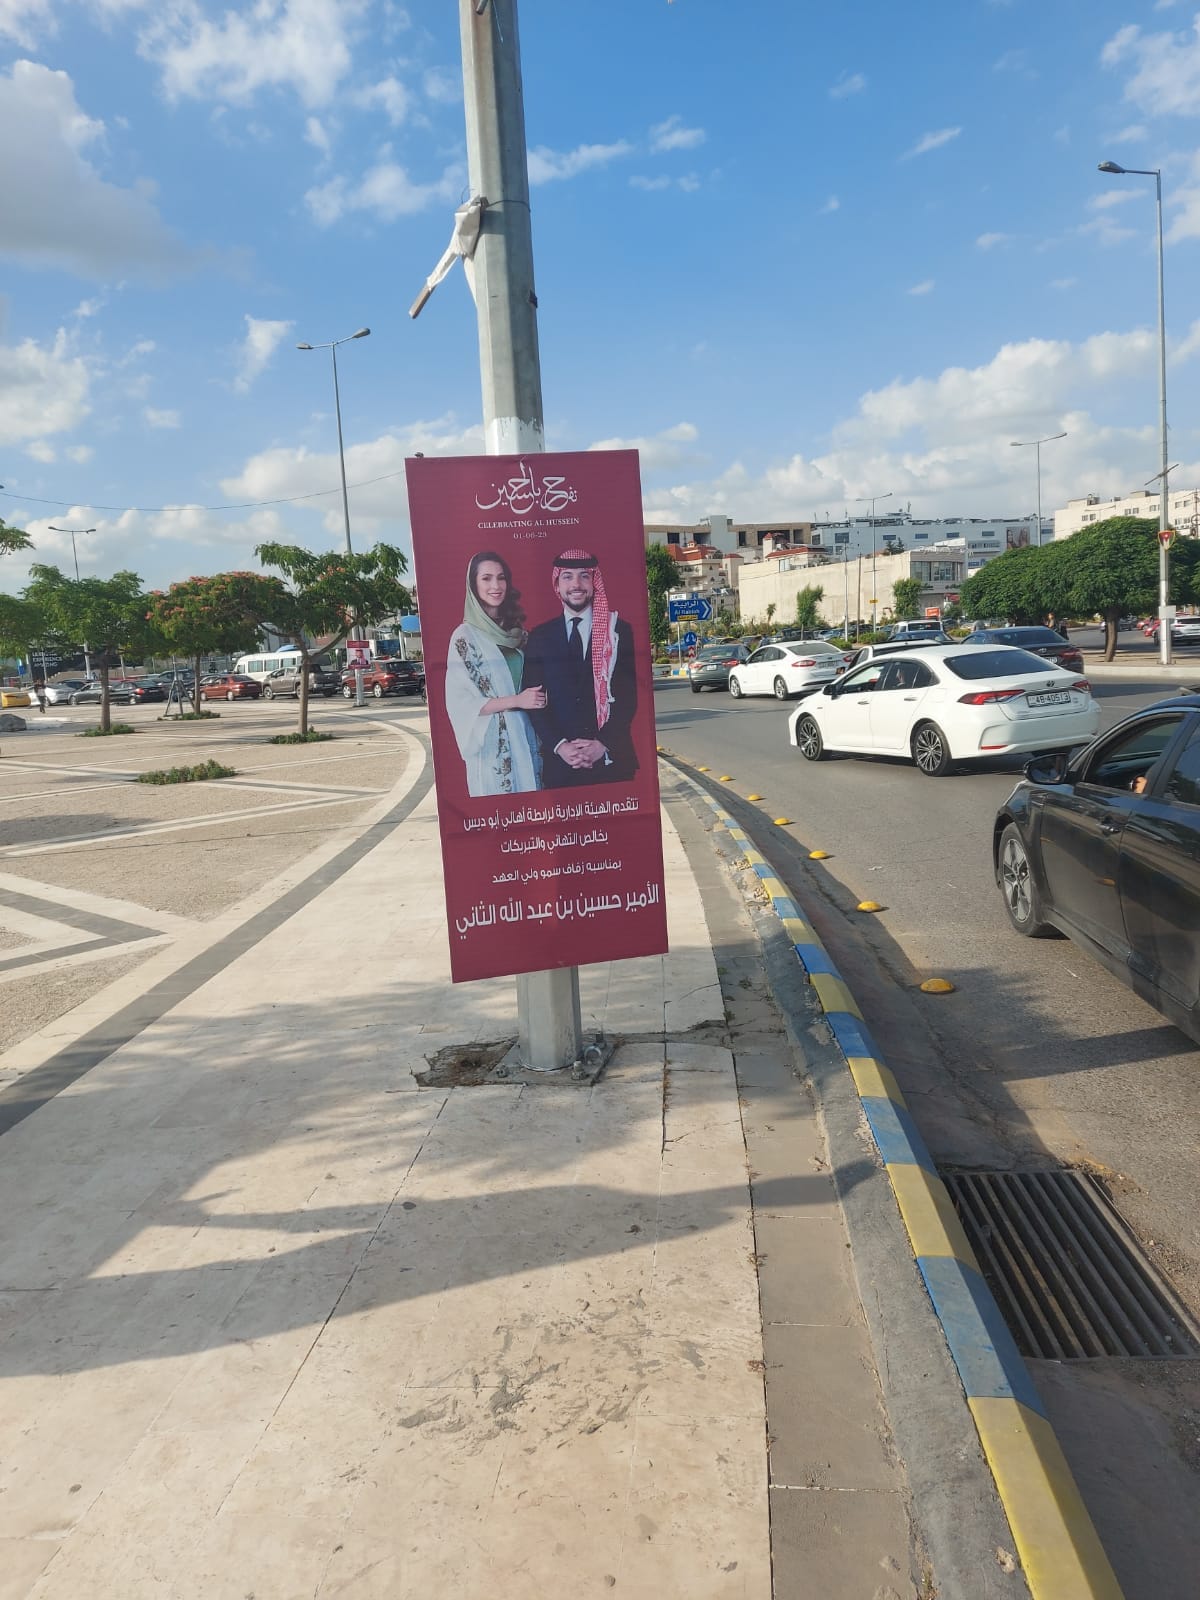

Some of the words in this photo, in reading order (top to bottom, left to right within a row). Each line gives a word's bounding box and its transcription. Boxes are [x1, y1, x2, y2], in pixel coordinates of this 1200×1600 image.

[477, 520, 533, 529] CELEBRATING
[546, 517, 580, 526] HUSSEIN
[526, 806, 555, 824] لرابطة
[585, 801, 610, 819] الهيئة
[612, 797, 639, 816] تتقدم
[463, 816, 487, 832] ديس
[488, 808, 500, 830] أبو
[501, 806, 525, 832] أهالي
[500, 836, 546, 855] والتبريكات
[547, 832, 577, 855] التهاني
[579, 829, 609, 847] بخالص
[491, 869, 519, 884] العهد
[520, 867, 539, 886] ولي
[540, 866, 561, 880] سمو
[562, 861, 585, 875] زفاف
[576, 891, 622, 918] حسين
[625, 881, 659, 912] الأمير
[500, 896, 523, 922] الله
[527, 901, 553, 925] عبد
[555, 895, 573, 921] بن
[455, 900, 497, 940] الثاني
